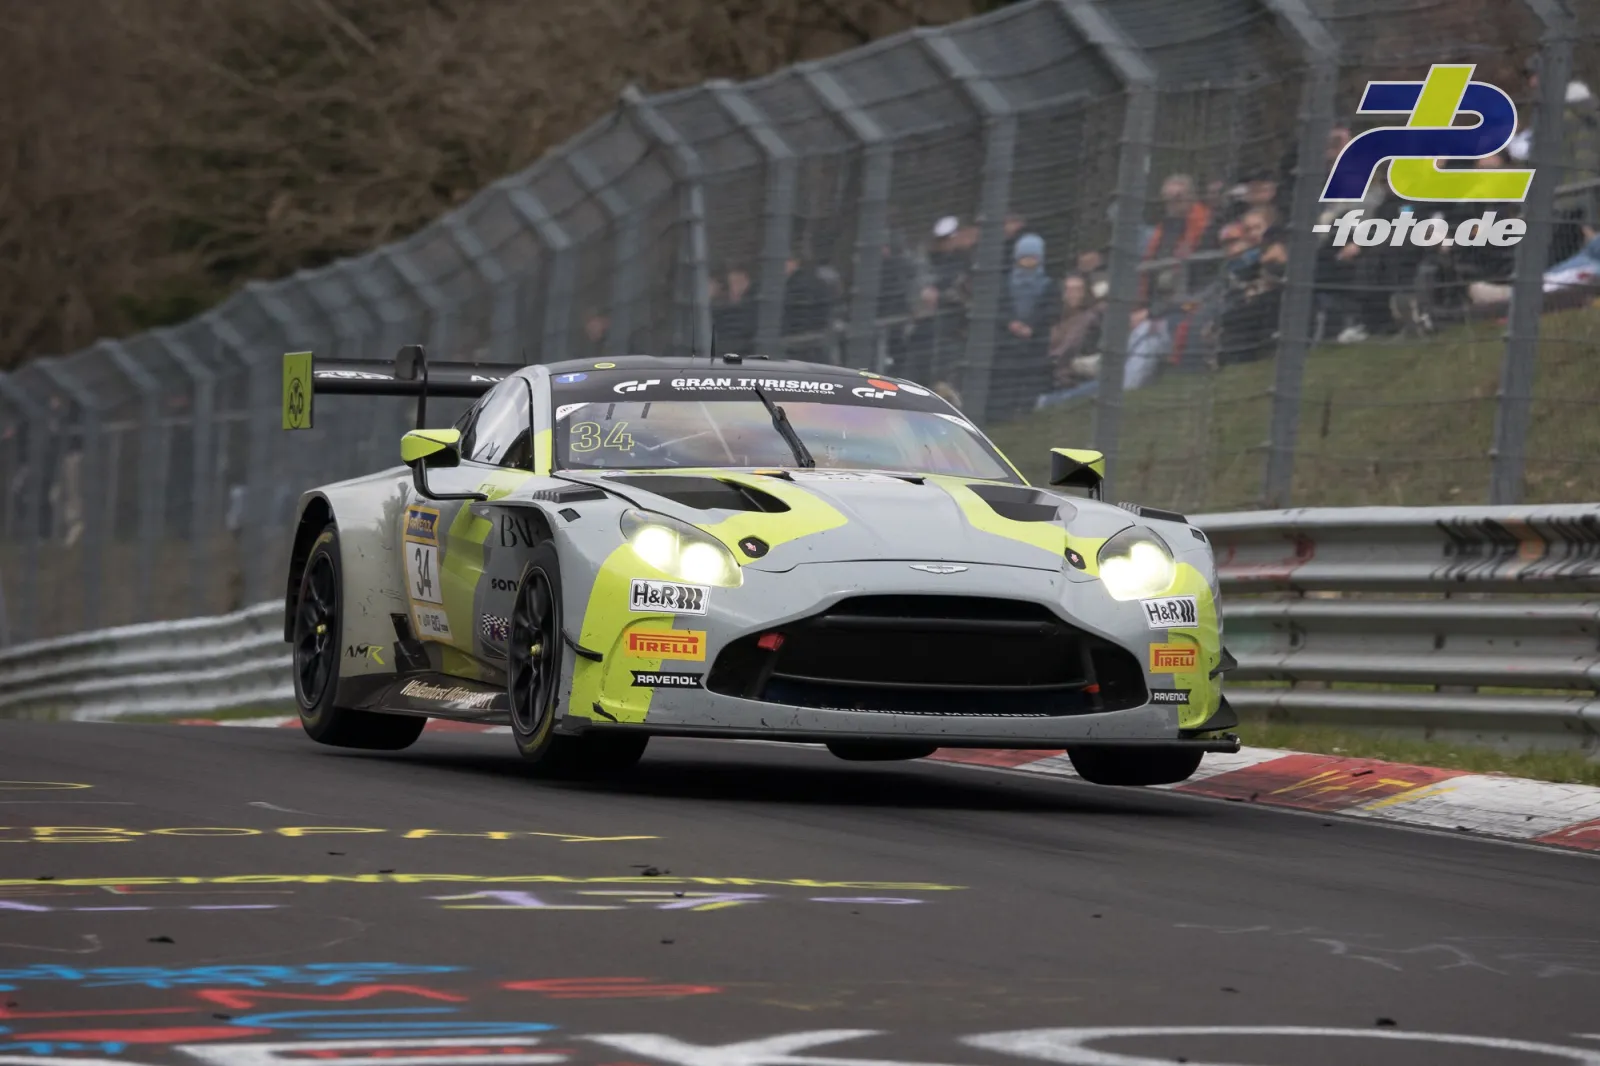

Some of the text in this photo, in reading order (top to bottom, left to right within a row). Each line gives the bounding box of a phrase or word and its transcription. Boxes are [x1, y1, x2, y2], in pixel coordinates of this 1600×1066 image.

[671, 378, 835, 391] GRAN TURISMO
[774, 387, 836, 395] SIMULATOR
[570, 422, 635, 452] 34
[415, 547, 433, 598] 34
[629, 633, 699, 654] PIRELLI
[1154, 649, 1195, 667] PIRELLI
[637, 675, 698, 685] RAVENOL
[1154, 692, 1187, 701] RAVENOL
